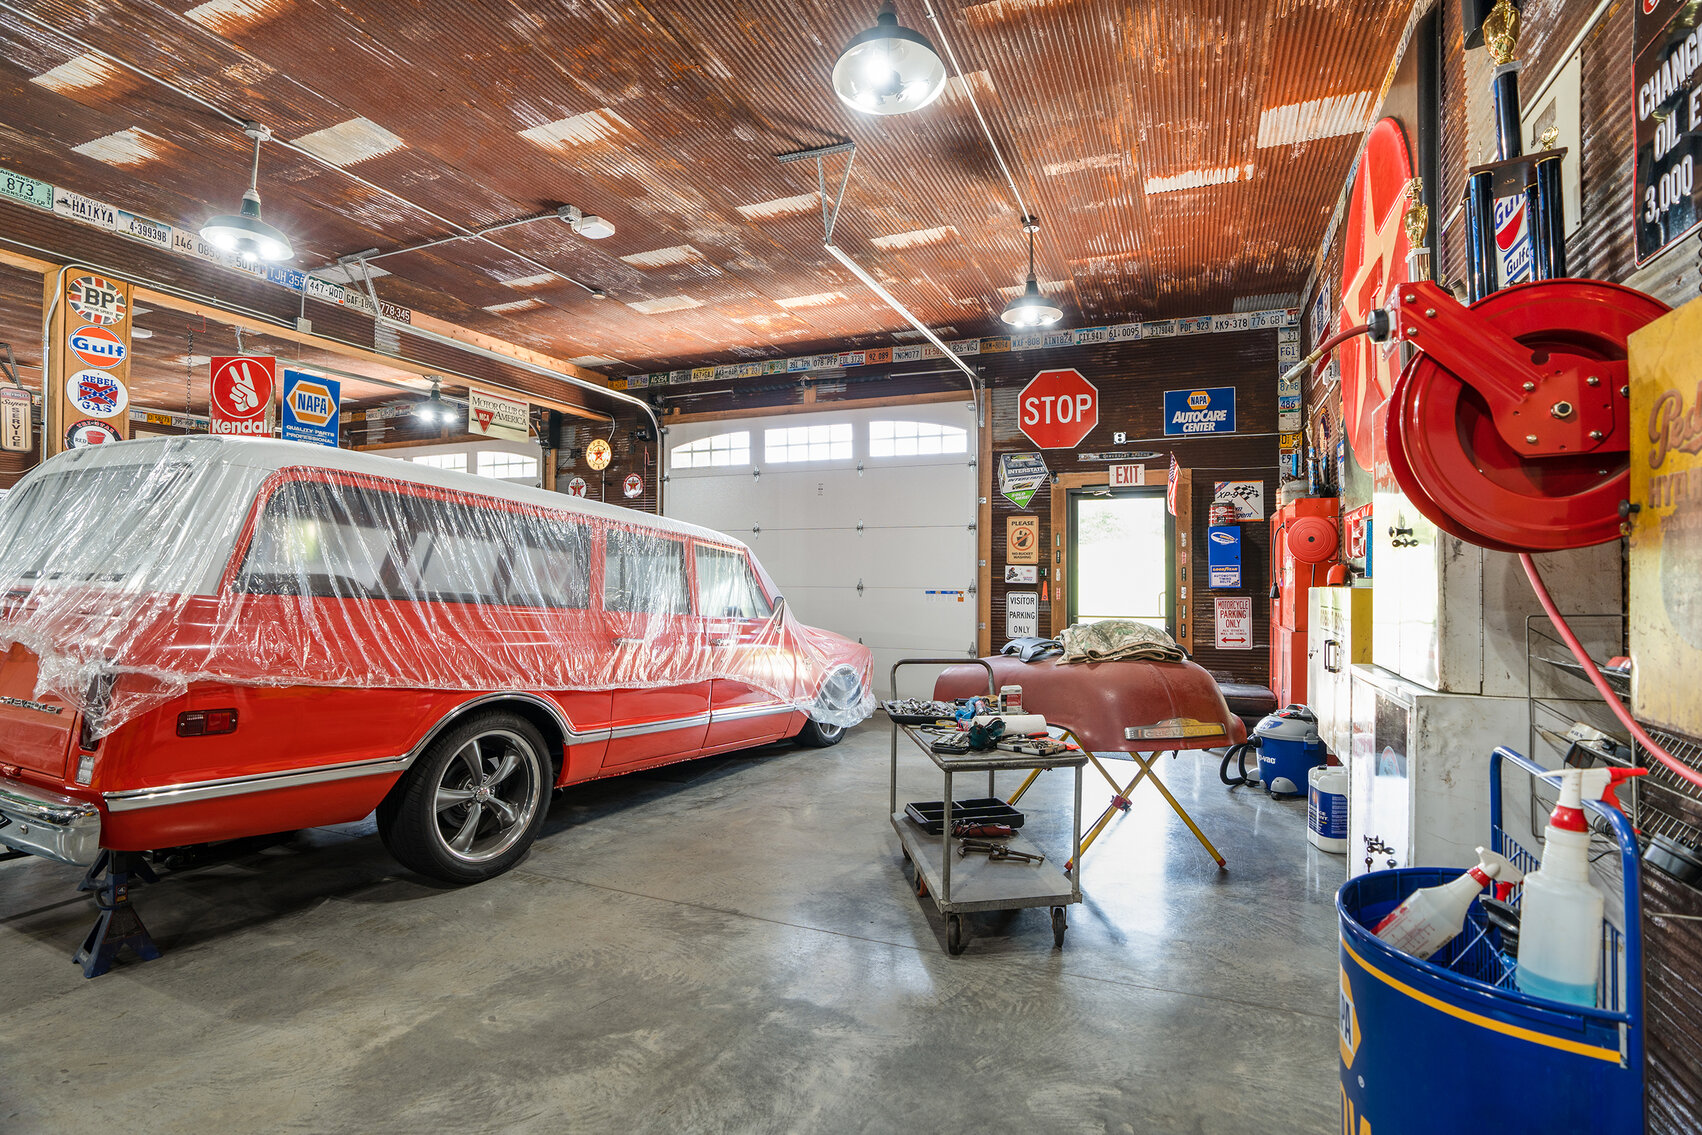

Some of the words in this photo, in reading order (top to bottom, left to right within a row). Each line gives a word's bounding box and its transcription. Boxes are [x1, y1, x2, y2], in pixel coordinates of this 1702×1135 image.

[1653, 108, 1682, 164] OIL
[7, 177, 34, 197] 873
[1644, 153, 1694, 224] 3,000
[84, 286, 116, 310] BP
[72, 336, 125, 358] Gulf
[82, 374, 118, 388] REBEL
[82, 401, 113, 414] GAS
[297, 393, 328, 415] NAPA
[472, 396, 499, 411] MOTOR
[1190, 396, 1208, 406] NAPA
[1023, 394, 1093, 426] STOP
[495, 411, 527, 426] AMERICA
[1647, 381, 1702, 469] Ped
[286, 424, 314, 434] QUALITY
[314, 429, 335, 438] PARTS
[1182, 421, 1216, 433] CENTER
[1115, 465, 1140, 484] EXIT
[1648, 467, 1702, 509] HYDR
[1010, 597, 1035, 606] VISITOR
[1217, 600, 1249, 610] MOTORCYCLE
[1009, 611, 1036, 620] PARKING
[1219, 609, 1247, 619] PARKING
[1013, 626, 1031, 635] ONLY
[1225, 619, 1241, 628] ONLY
